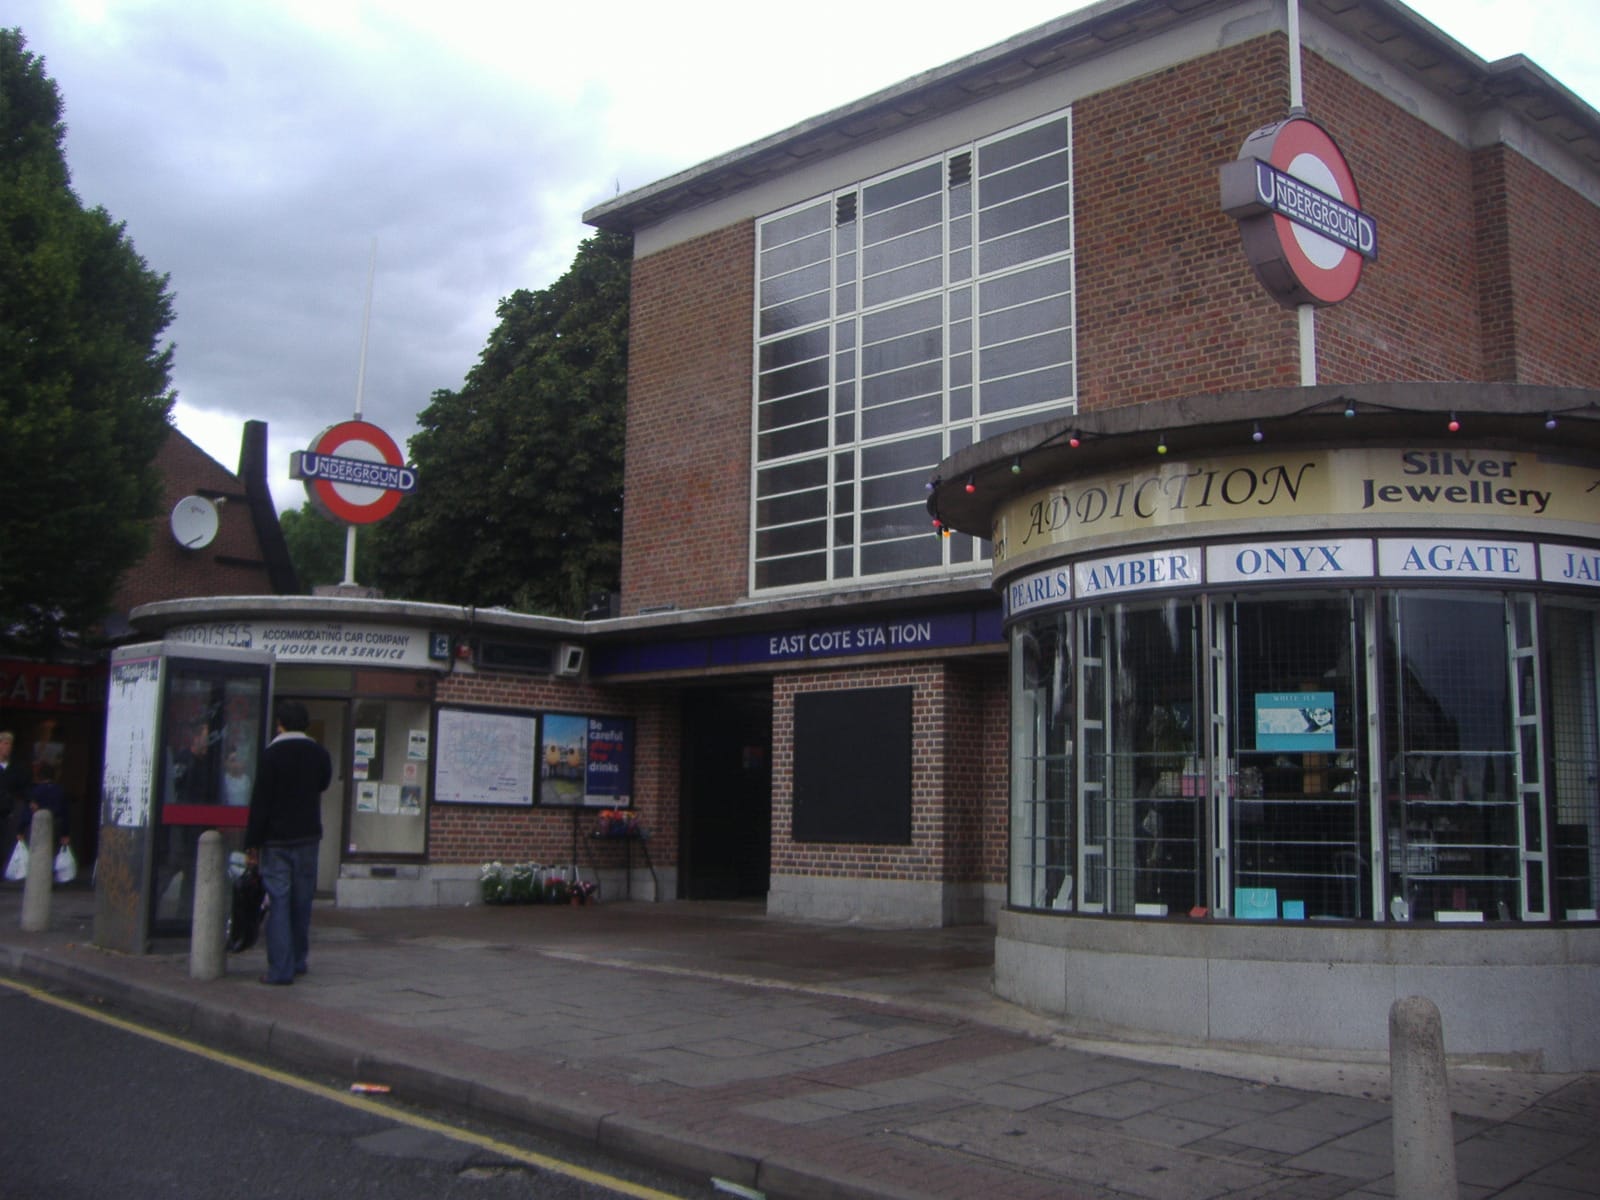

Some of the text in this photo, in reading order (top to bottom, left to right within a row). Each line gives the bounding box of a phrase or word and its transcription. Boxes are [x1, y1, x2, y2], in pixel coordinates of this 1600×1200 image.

[1256, 164, 1374, 252] UNDERGROUND
[301, 453, 415, 490] UNDERGROUND
[1402, 450, 1517, 478] Silver
[1022, 462, 1316, 545] ADDICTION
[1362, 479, 1552, 514] Jewellery
[1011, 571, 1068, 609] PEARLS
[1084, 554, 1192, 592] AMBER
[1235, 544, 1344, 575] ONYX
[1402, 544, 1520, 574] AGATE
[262, 627, 342, 642] ACCOMMODATING
[344, 631, 364, 643] CAR
[366, 632, 411, 647] COMPANY
[278, 643, 318, 656] HOUR
[319, 645, 348, 657] CAR
[349, 646, 406, 660] SERVICE
[769, 634, 807, 655] EAST
[809, 630, 852, 652] COTE
